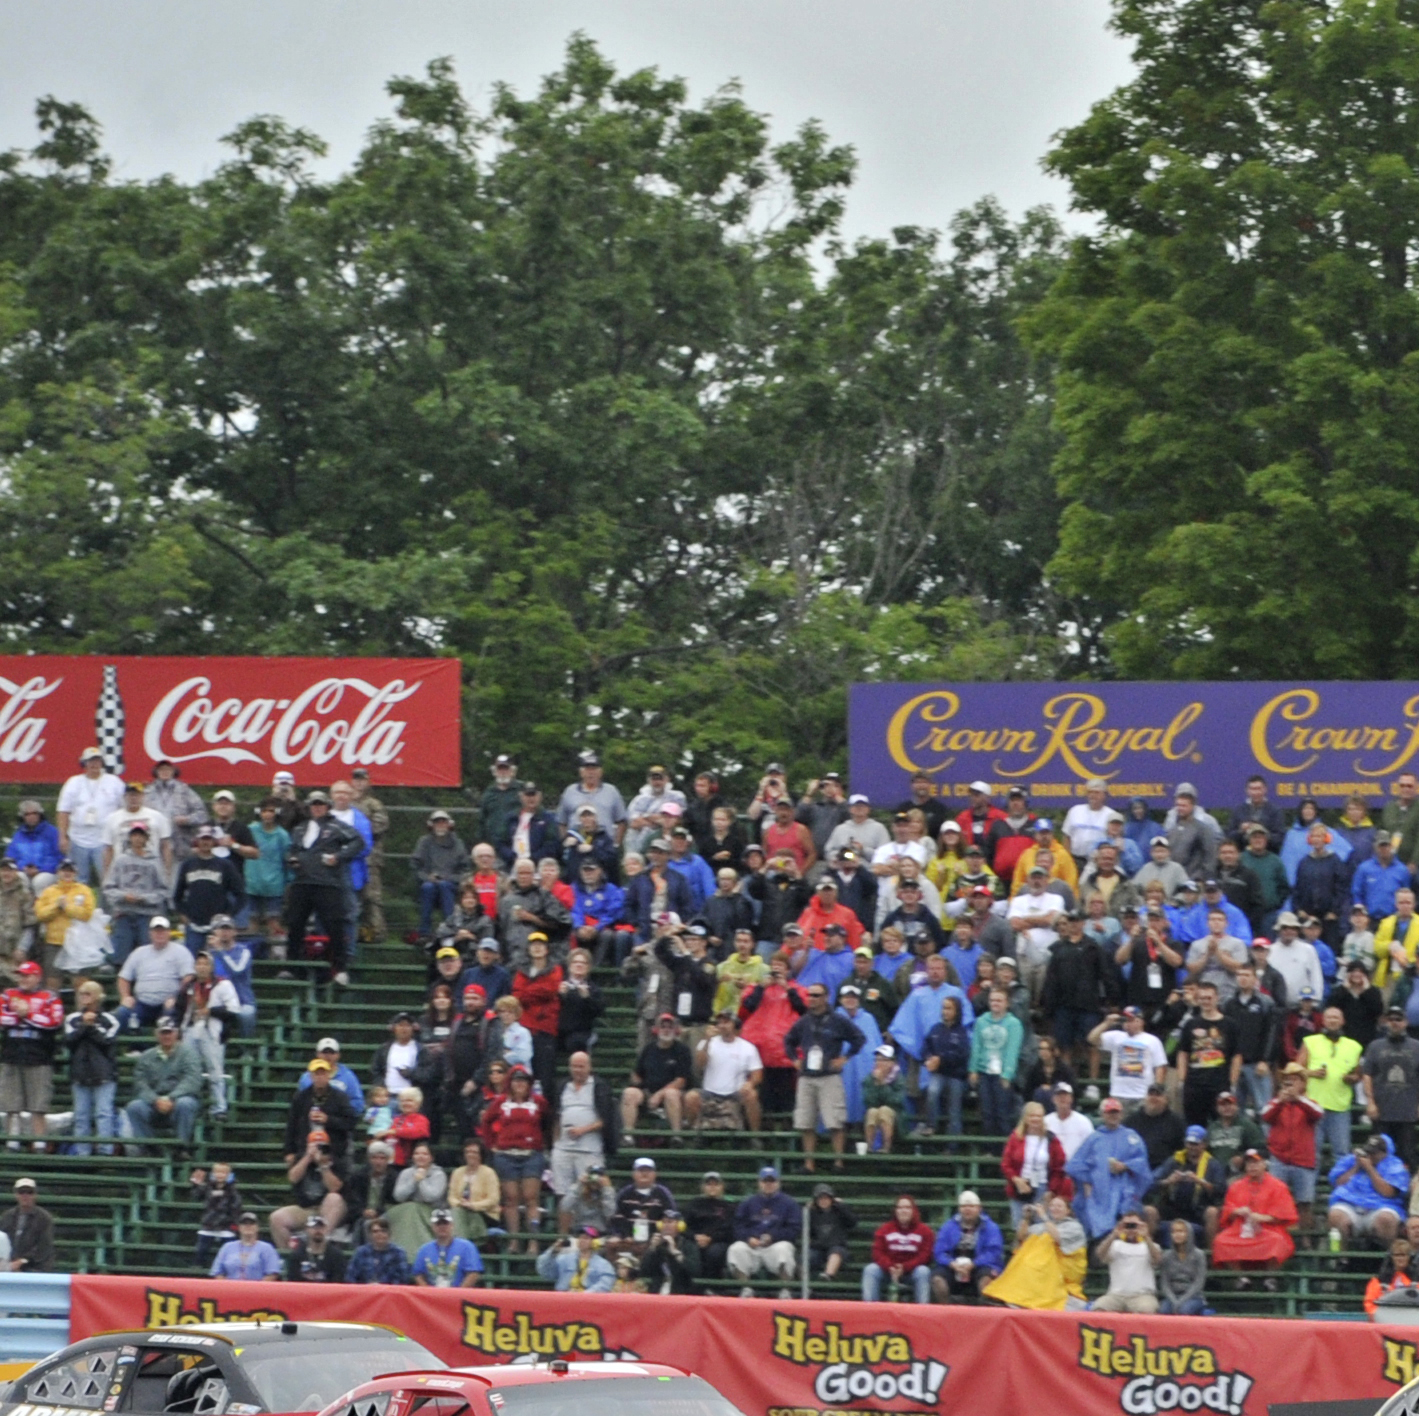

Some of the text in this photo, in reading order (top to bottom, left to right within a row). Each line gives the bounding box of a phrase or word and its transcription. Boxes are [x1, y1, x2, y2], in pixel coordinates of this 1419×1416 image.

[143, 676, 423, 765] Coca-Cola
[886, 690, 1203, 779] Crown Royal
[1250, 689, 1398, 773] Crown
[463, 1303, 603, 1354] Heluva
[773, 1314, 911, 1364] Heluva
[1080, 1326, 1216, 1377] Heluva
[815, 1360, 949, 1405] Good!
[1121, 1373, 1254, 1416] Good!
